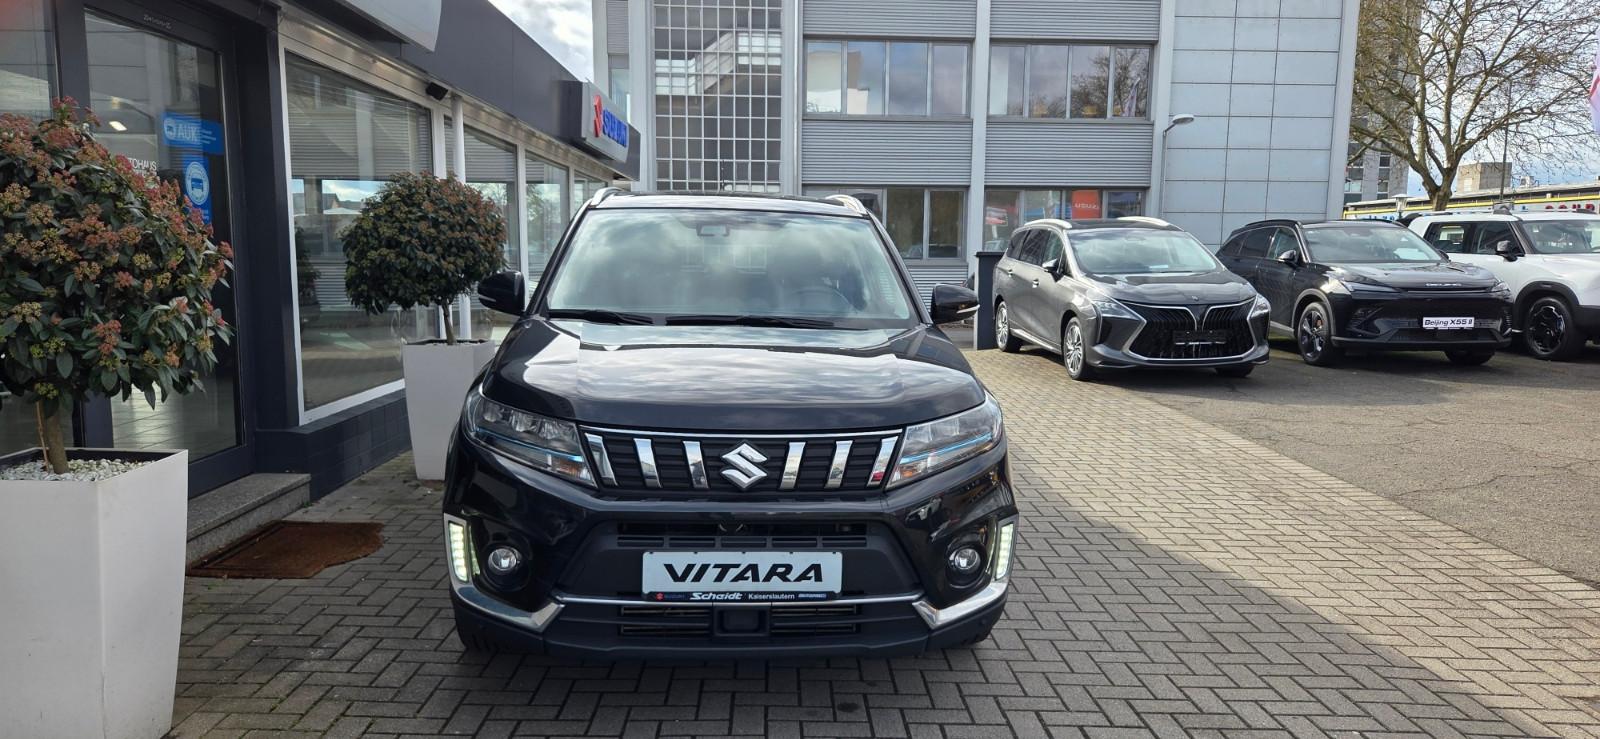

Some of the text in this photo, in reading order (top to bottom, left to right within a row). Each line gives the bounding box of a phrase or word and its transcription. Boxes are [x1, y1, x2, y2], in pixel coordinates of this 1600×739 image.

[1424, 319, 1449, 327] Beijing
[663, 563, 823, 583] VITARA
[689, 592, 743, 600] Scheidt
